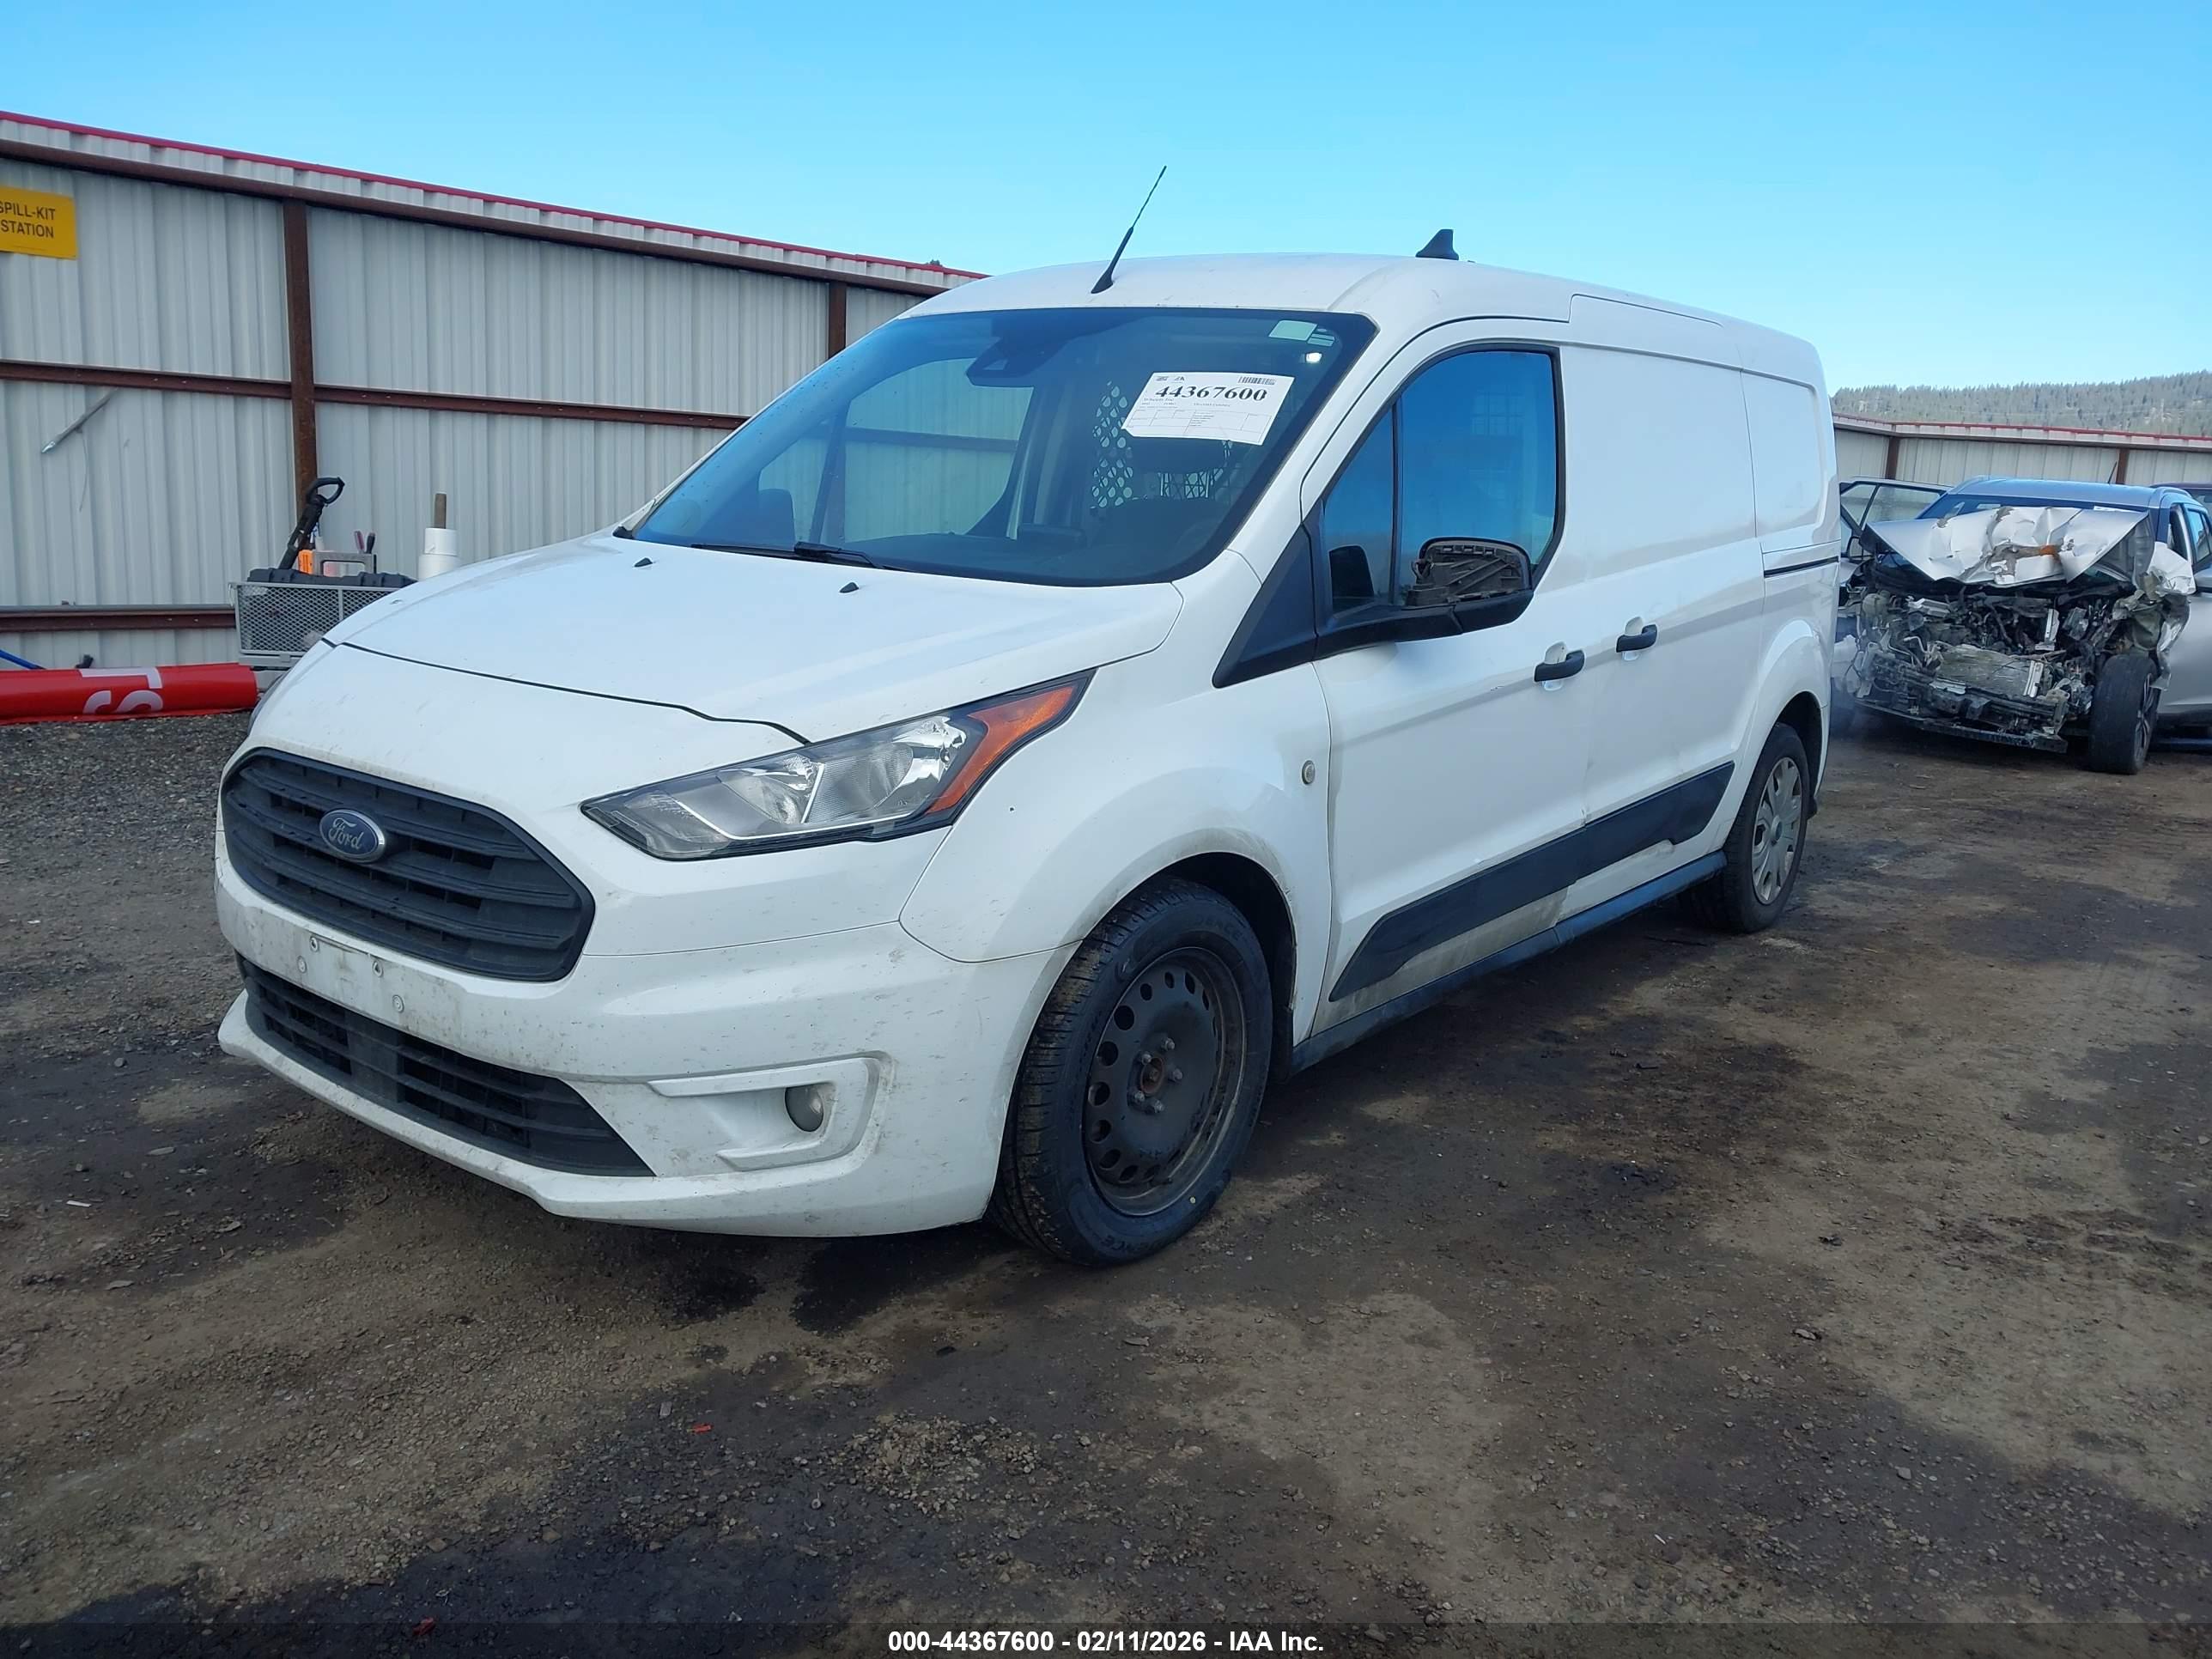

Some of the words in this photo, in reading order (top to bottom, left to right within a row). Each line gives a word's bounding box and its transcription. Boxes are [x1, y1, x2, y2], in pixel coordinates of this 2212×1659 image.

[0, 219, 54, 238] STATION
[1155, 386, 1267, 401] 44367600
[328, 817, 364, 849] Ford
